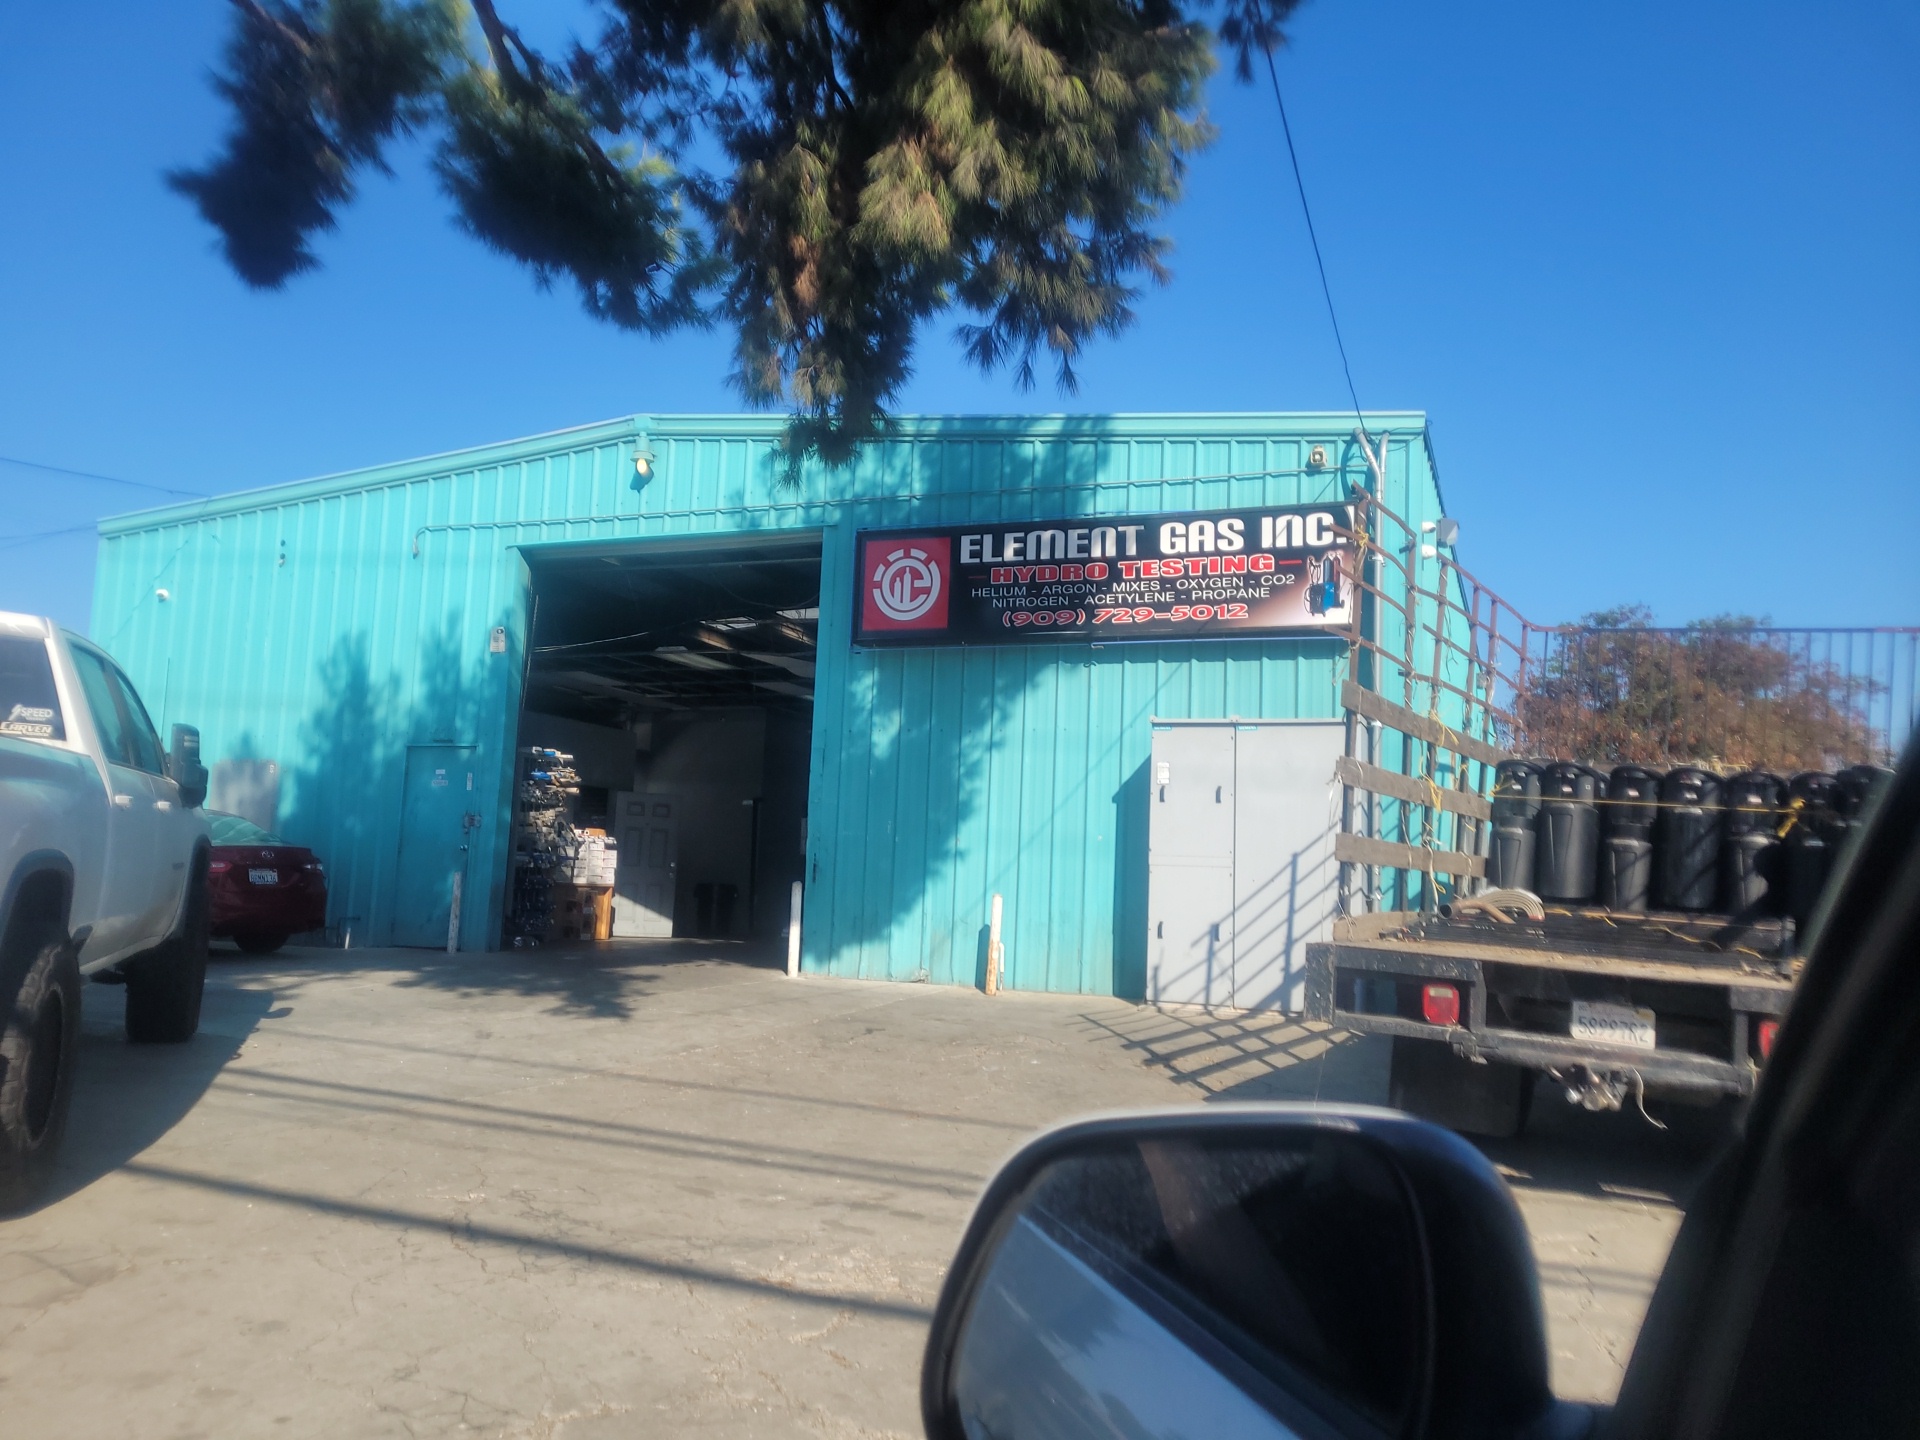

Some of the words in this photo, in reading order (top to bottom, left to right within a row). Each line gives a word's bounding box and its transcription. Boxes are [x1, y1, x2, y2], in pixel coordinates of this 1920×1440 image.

[960, 525, 1145, 564] ELEMENT
[1159, 518, 1245, 555] GAS
[990, 562, 1109, 585] HYDRO
[1118, 554, 1274, 579] TESTING
[971, 586, 1027, 598] HELIUM
[1041, 583, 1097, 596] ARGON
[1112, 580, 1160, 593] MIXES
[1176, 577, 1244, 590] OXYGEN
[1260, 574, 1295, 586] CO2
[992, 596, 1069, 608] NITROGEN
[1084, 591, 1176, 605] ACETYLENE
[1191, 587, 1271, 601] PROPANE
[1002, 608, 1086, 628] (909)
[1092, 603, 1249, 624] 729-5012
